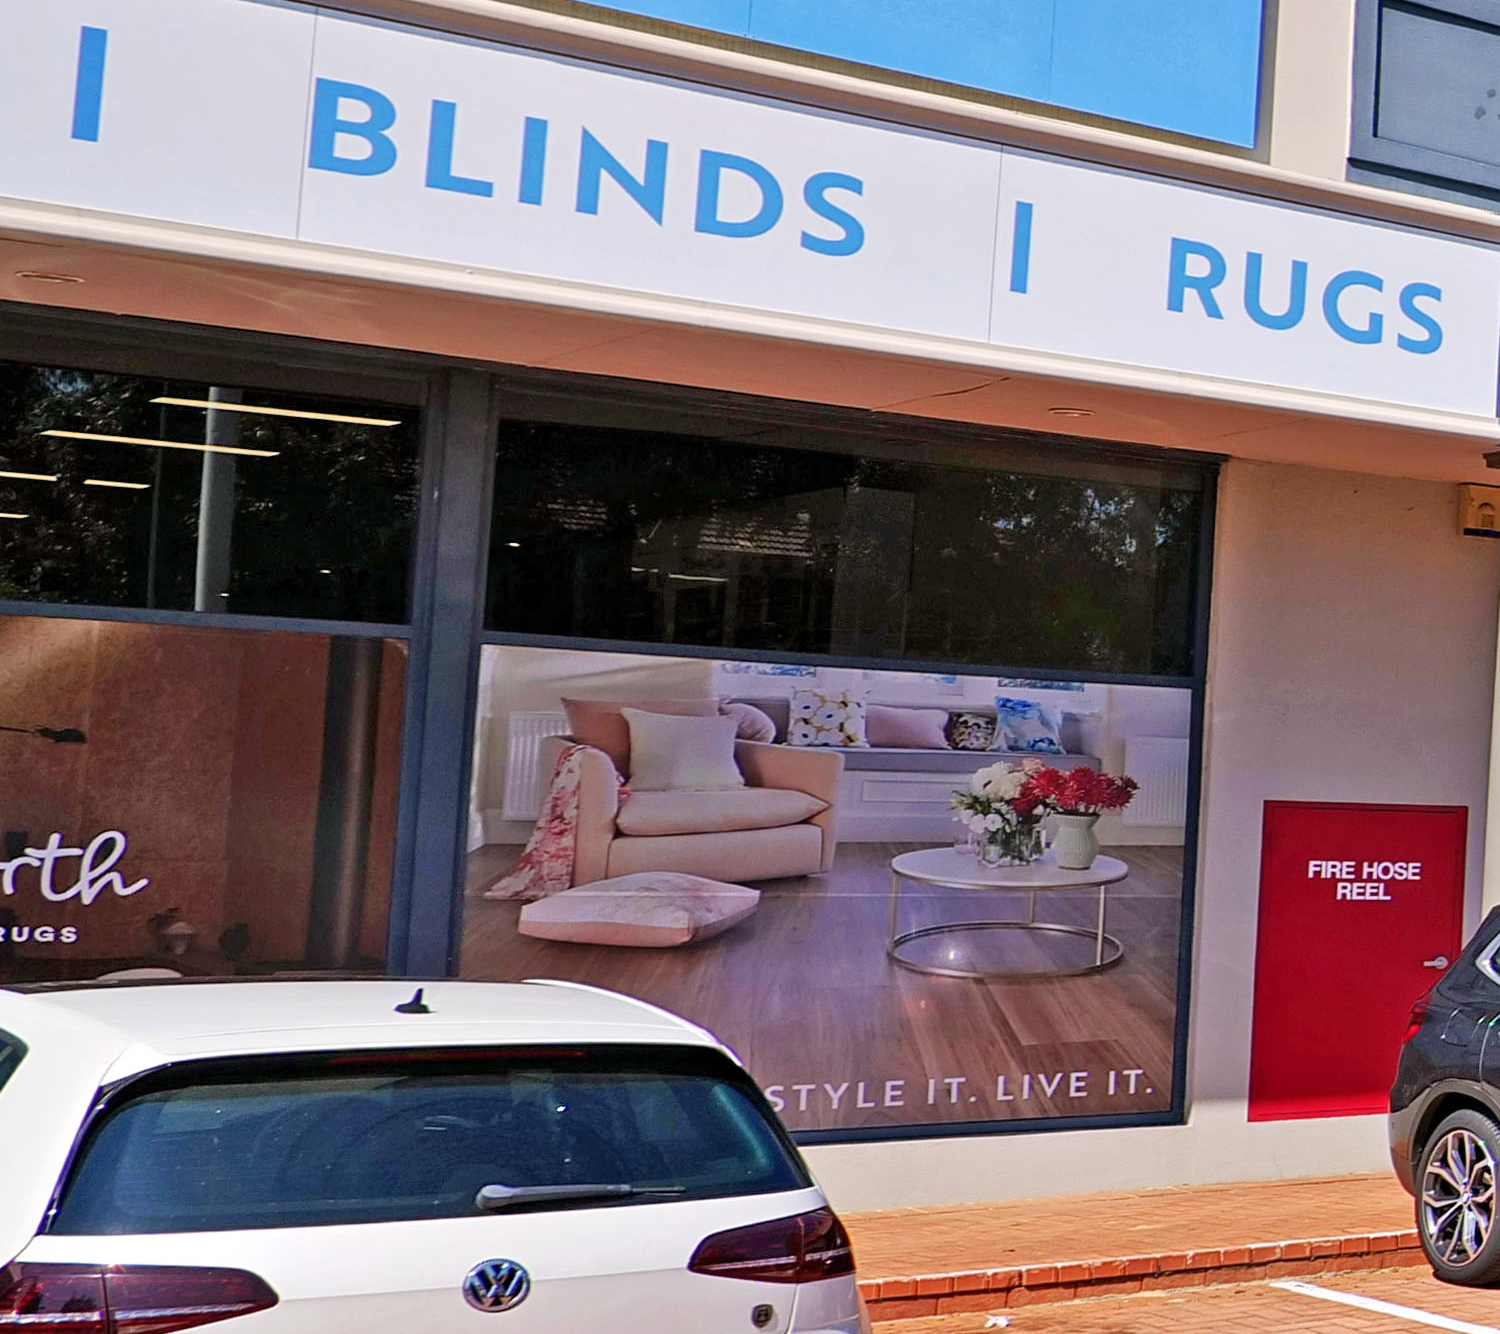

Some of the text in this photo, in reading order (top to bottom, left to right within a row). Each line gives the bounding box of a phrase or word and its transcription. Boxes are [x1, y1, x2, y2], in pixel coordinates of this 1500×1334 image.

[308, 77, 865, 257] BLINDS
[1167, 237, 1443, 355] RUGS
[1307, 860, 1421, 880] FIRE HOSE
[1336, 881, 1392, 901] REEL
[764, 1068, 1154, 1113] STYLE IT. LIVE IT.
